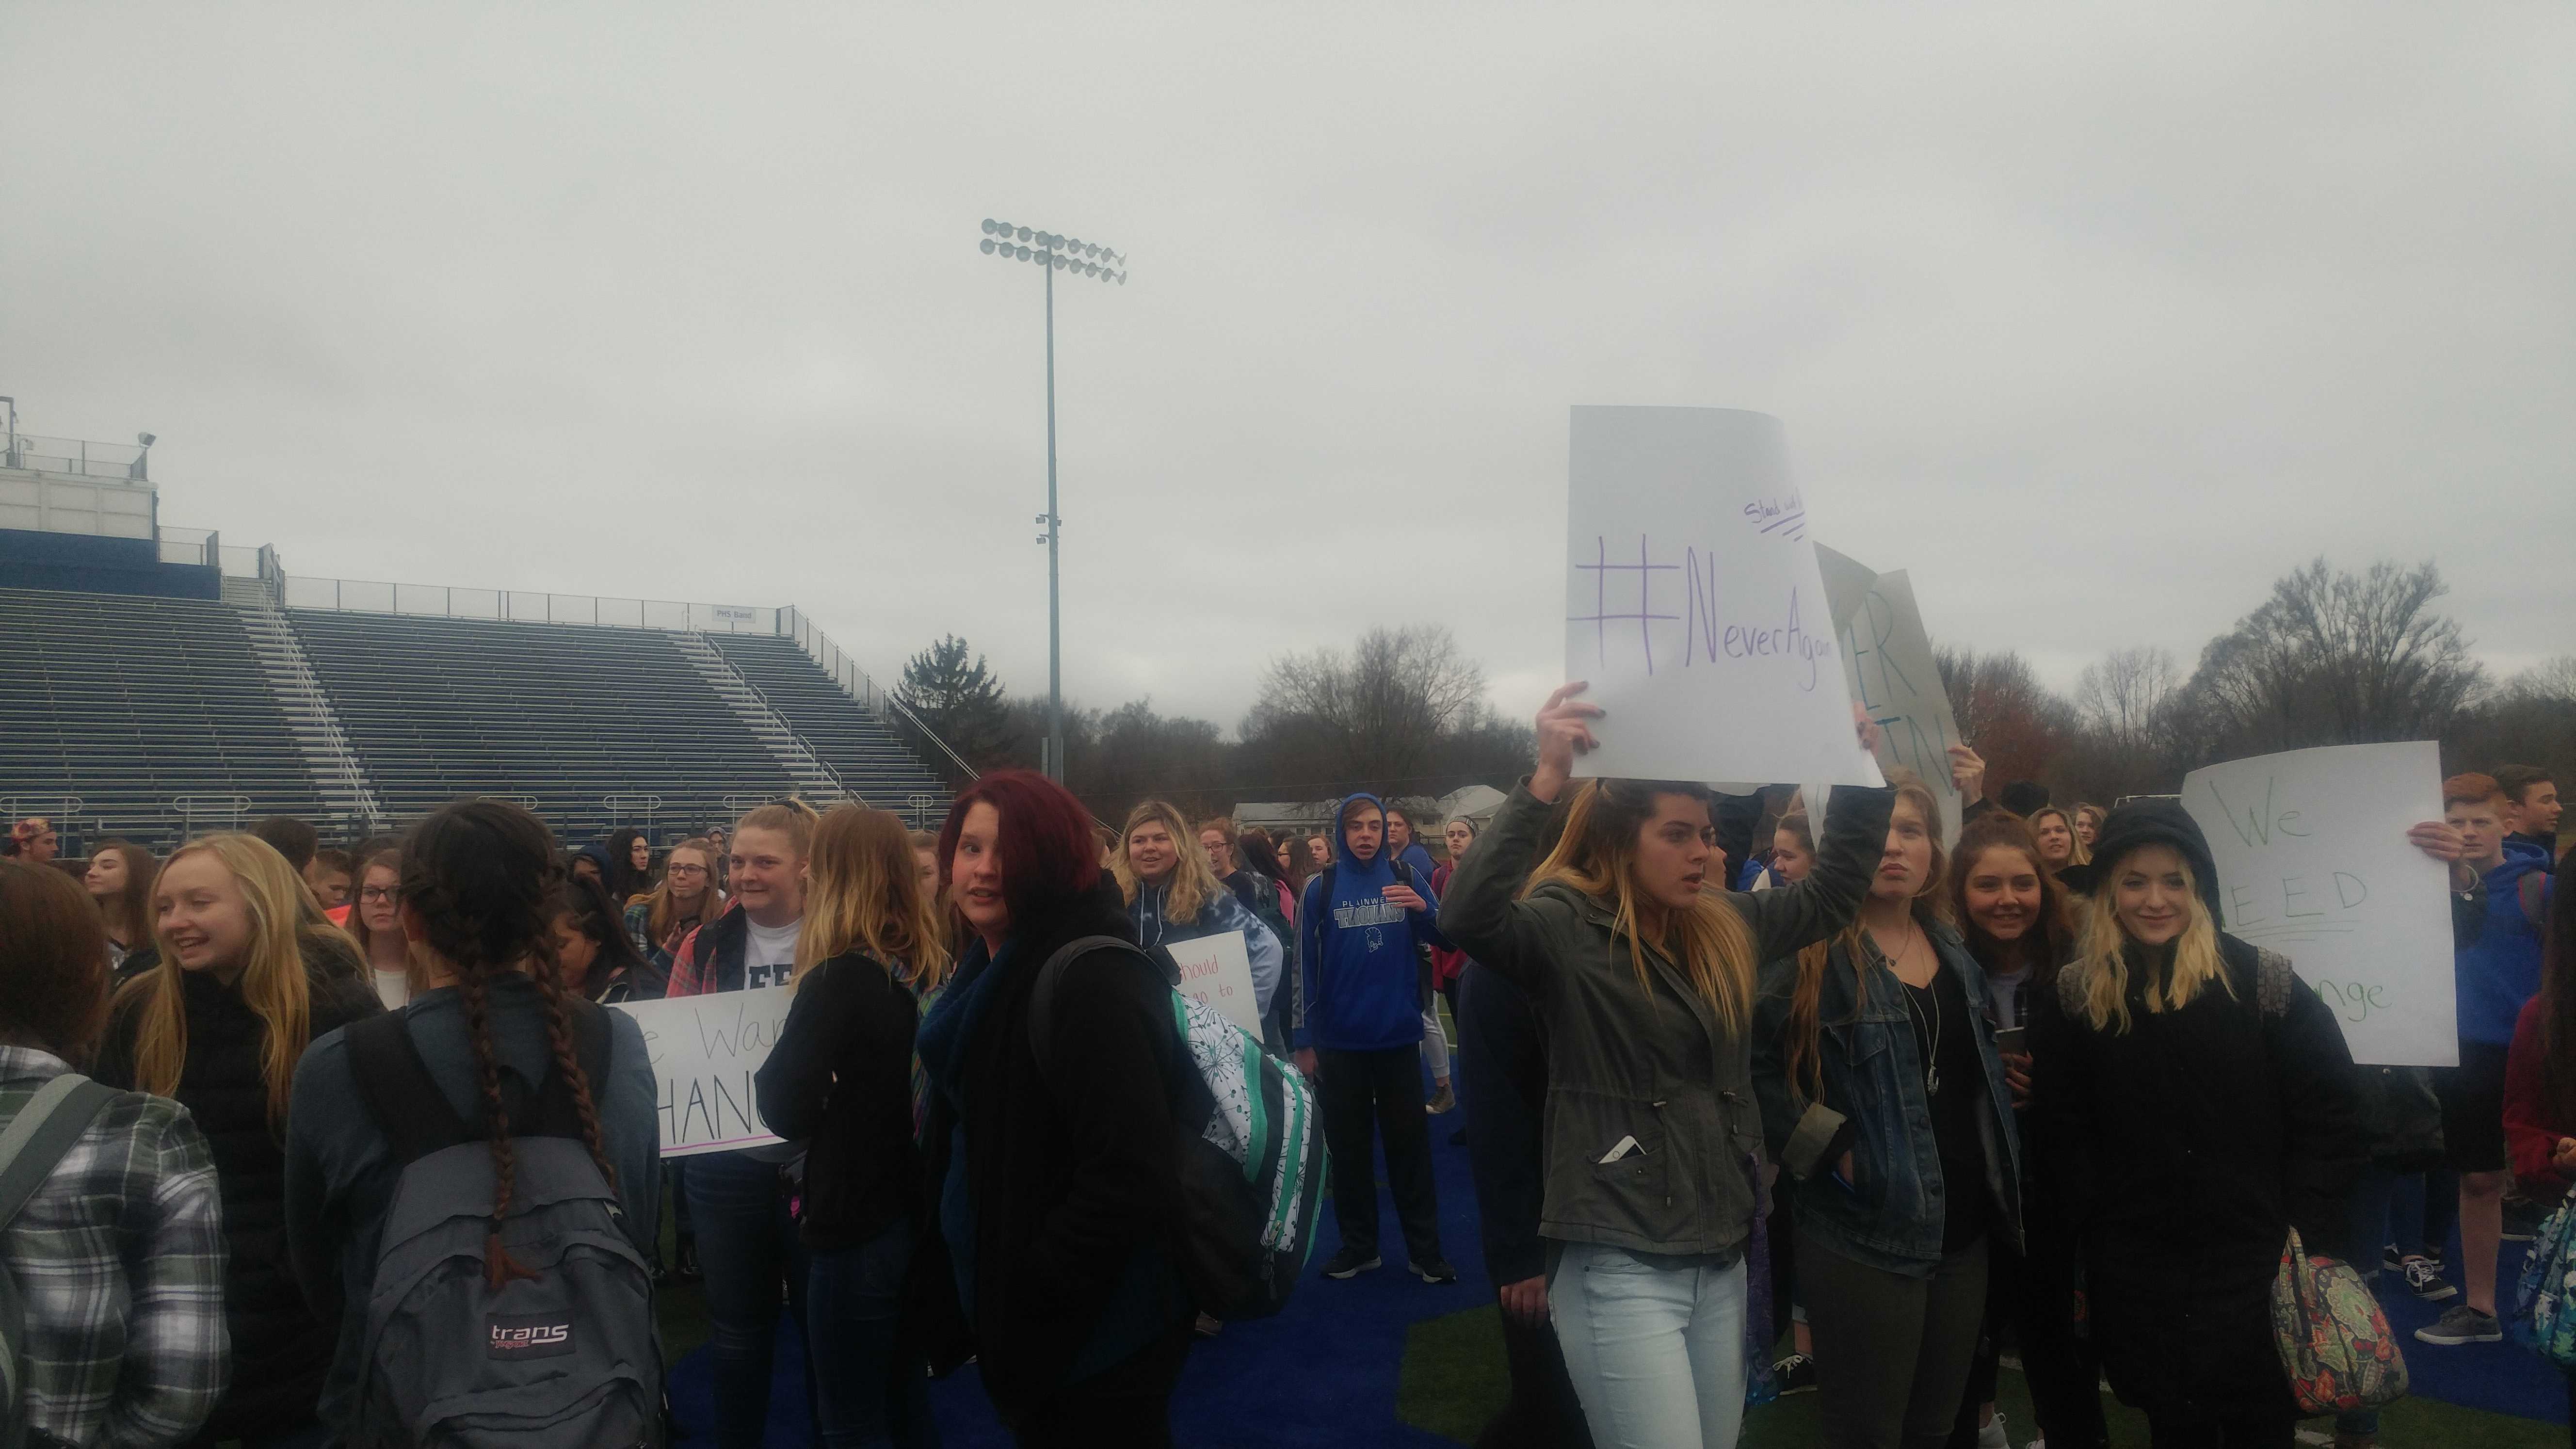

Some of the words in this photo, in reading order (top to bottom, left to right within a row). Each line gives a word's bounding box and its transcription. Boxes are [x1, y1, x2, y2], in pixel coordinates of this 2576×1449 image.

[2208, 776, 2312, 848] We
[2221, 871, 2367, 928] EED
[1333, 902, 1405, 929] TROJANS
[1178, 953, 1219, 981] hould
[1219, 983, 1233, 997] to
[2314, 979, 2393, 1022] nge
[492, 1323, 570, 1344] trans
